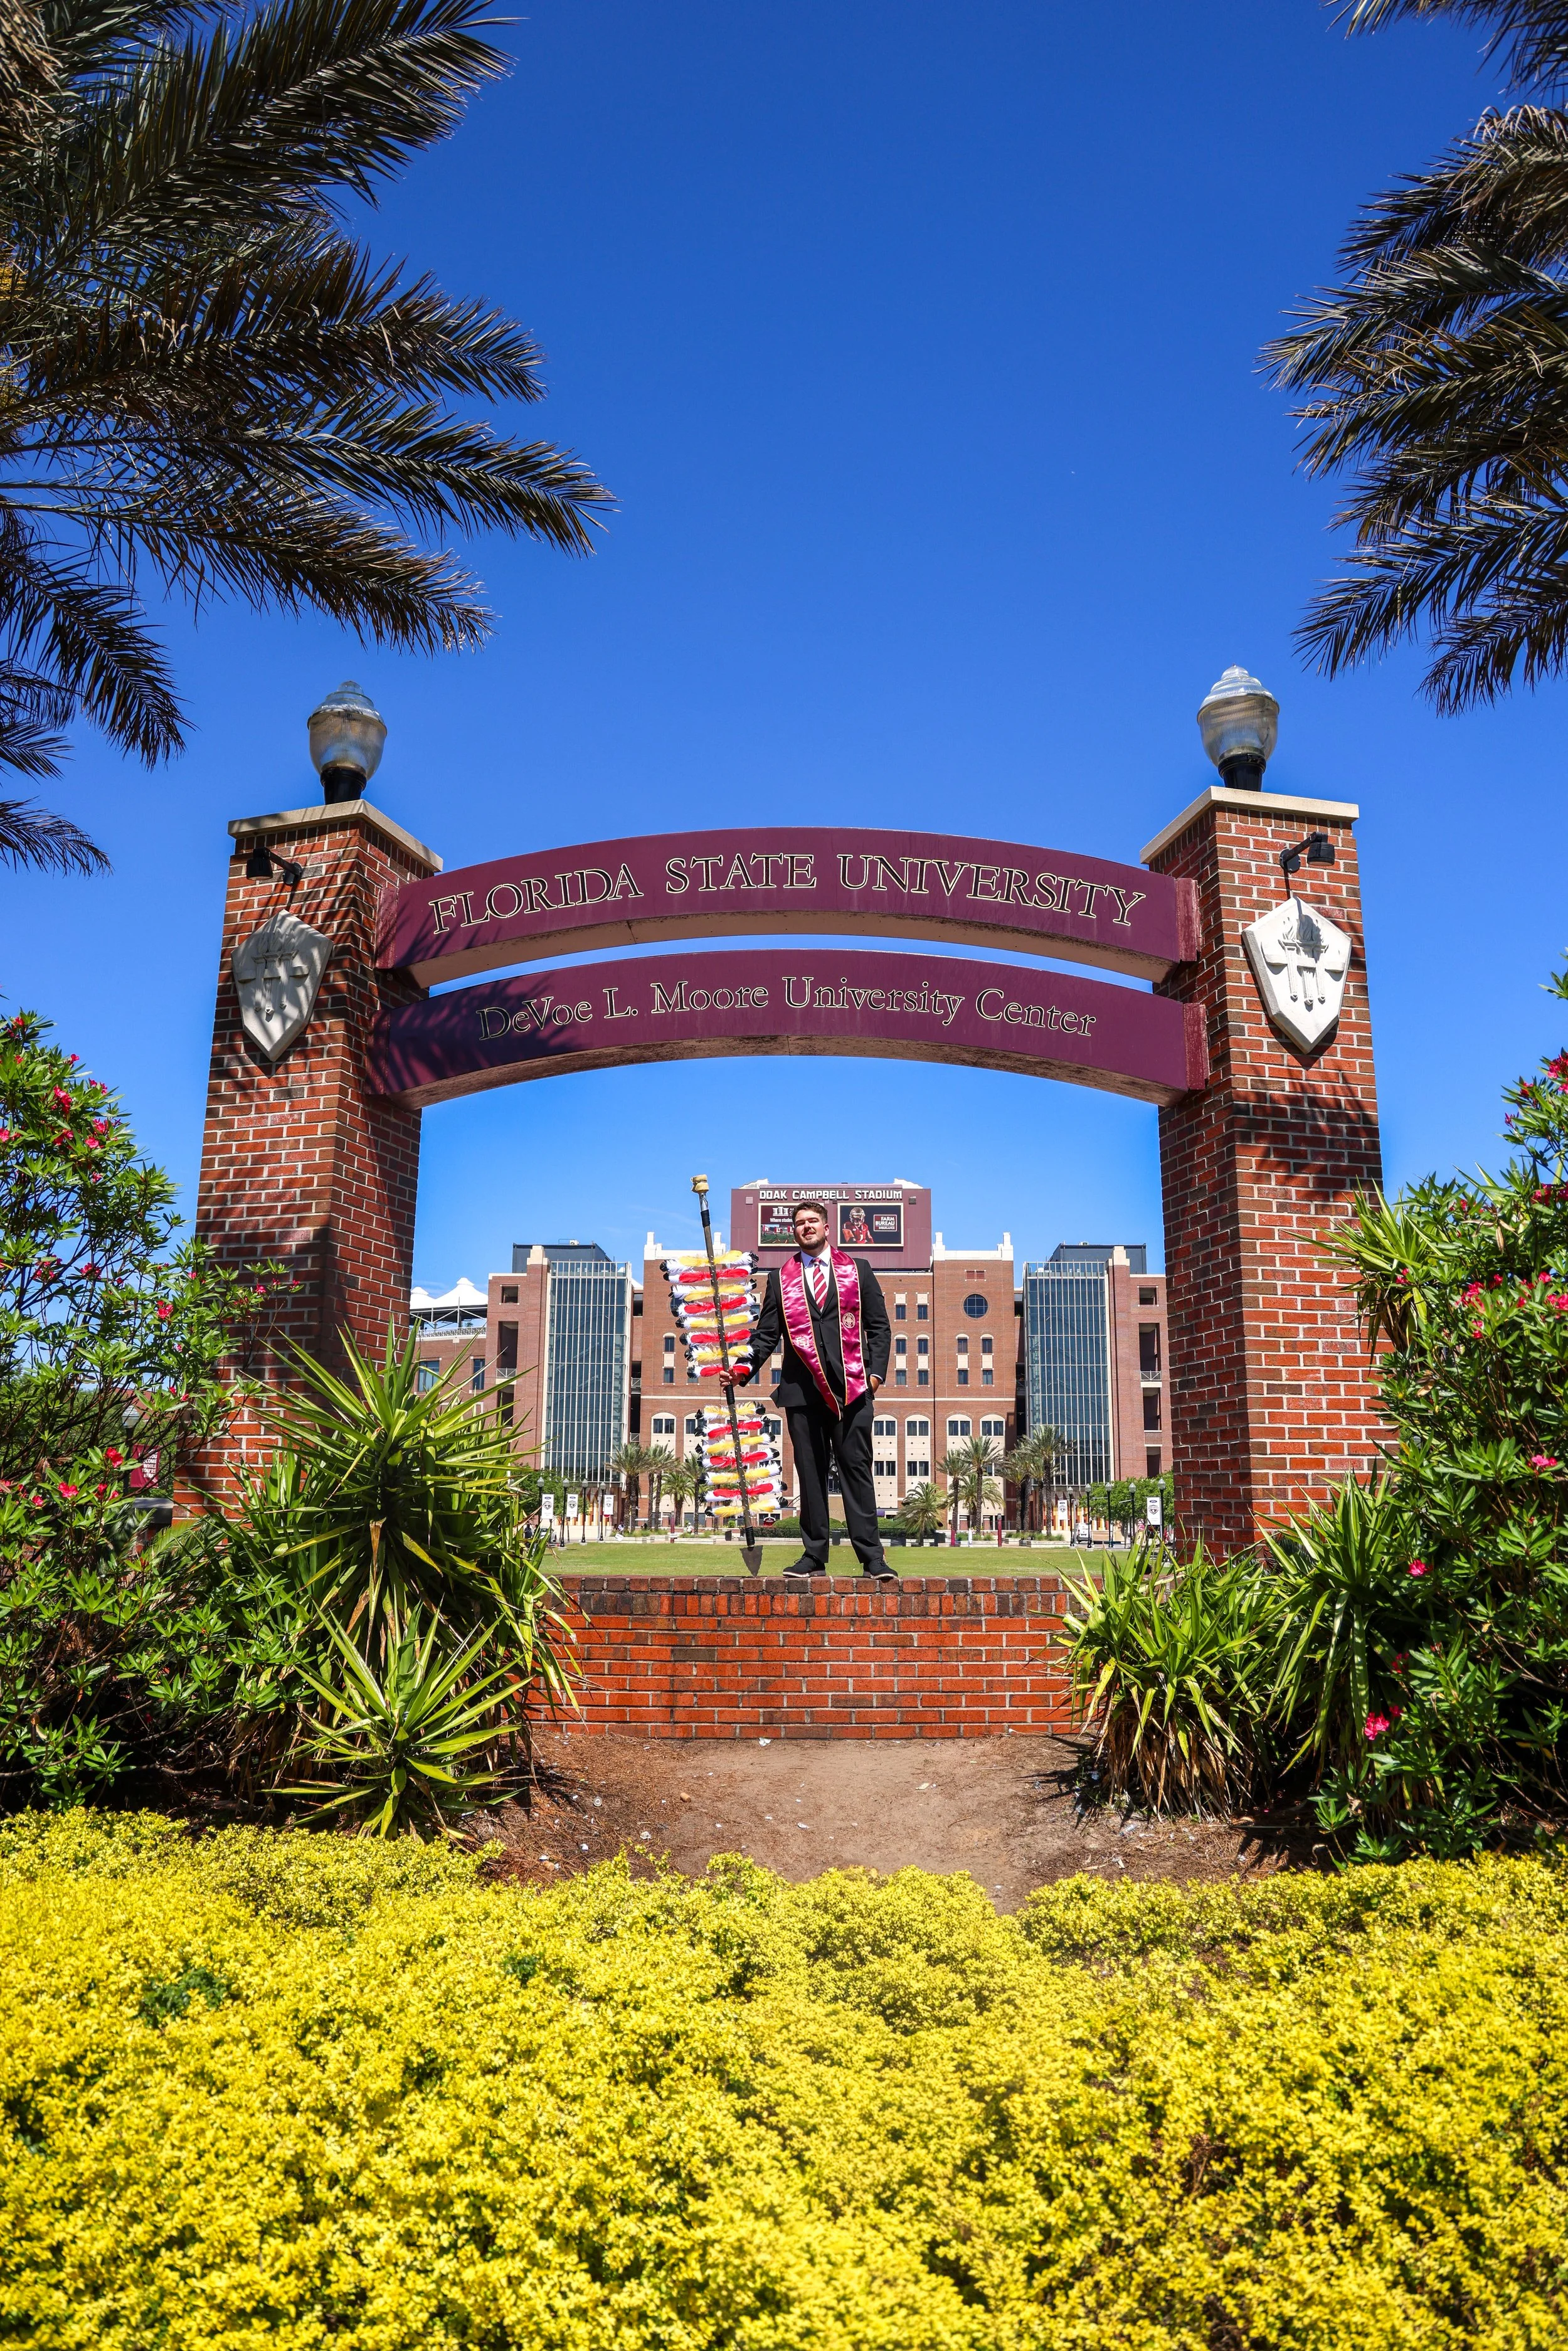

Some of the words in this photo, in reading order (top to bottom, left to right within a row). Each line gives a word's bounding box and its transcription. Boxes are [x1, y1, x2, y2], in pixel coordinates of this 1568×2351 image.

[428, 863, 644, 935] FLORIDA
[666, 852, 817, 894] STATE
[837, 854, 1146, 926] UNIVERSITY
[475, 996, 593, 1041] DeVoe
[602, 987, 638, 1019] L.
[650, 980, 768, 1014] Moore
[782, 976, 964, 1026] University
[975, 988, 1096, 1036] Center
[759, 1190, 787, 1200] DOAK
[792, 1190, 849, 1200] CAMPBELL
[855, 1190, 903, 1200] STADIUM
